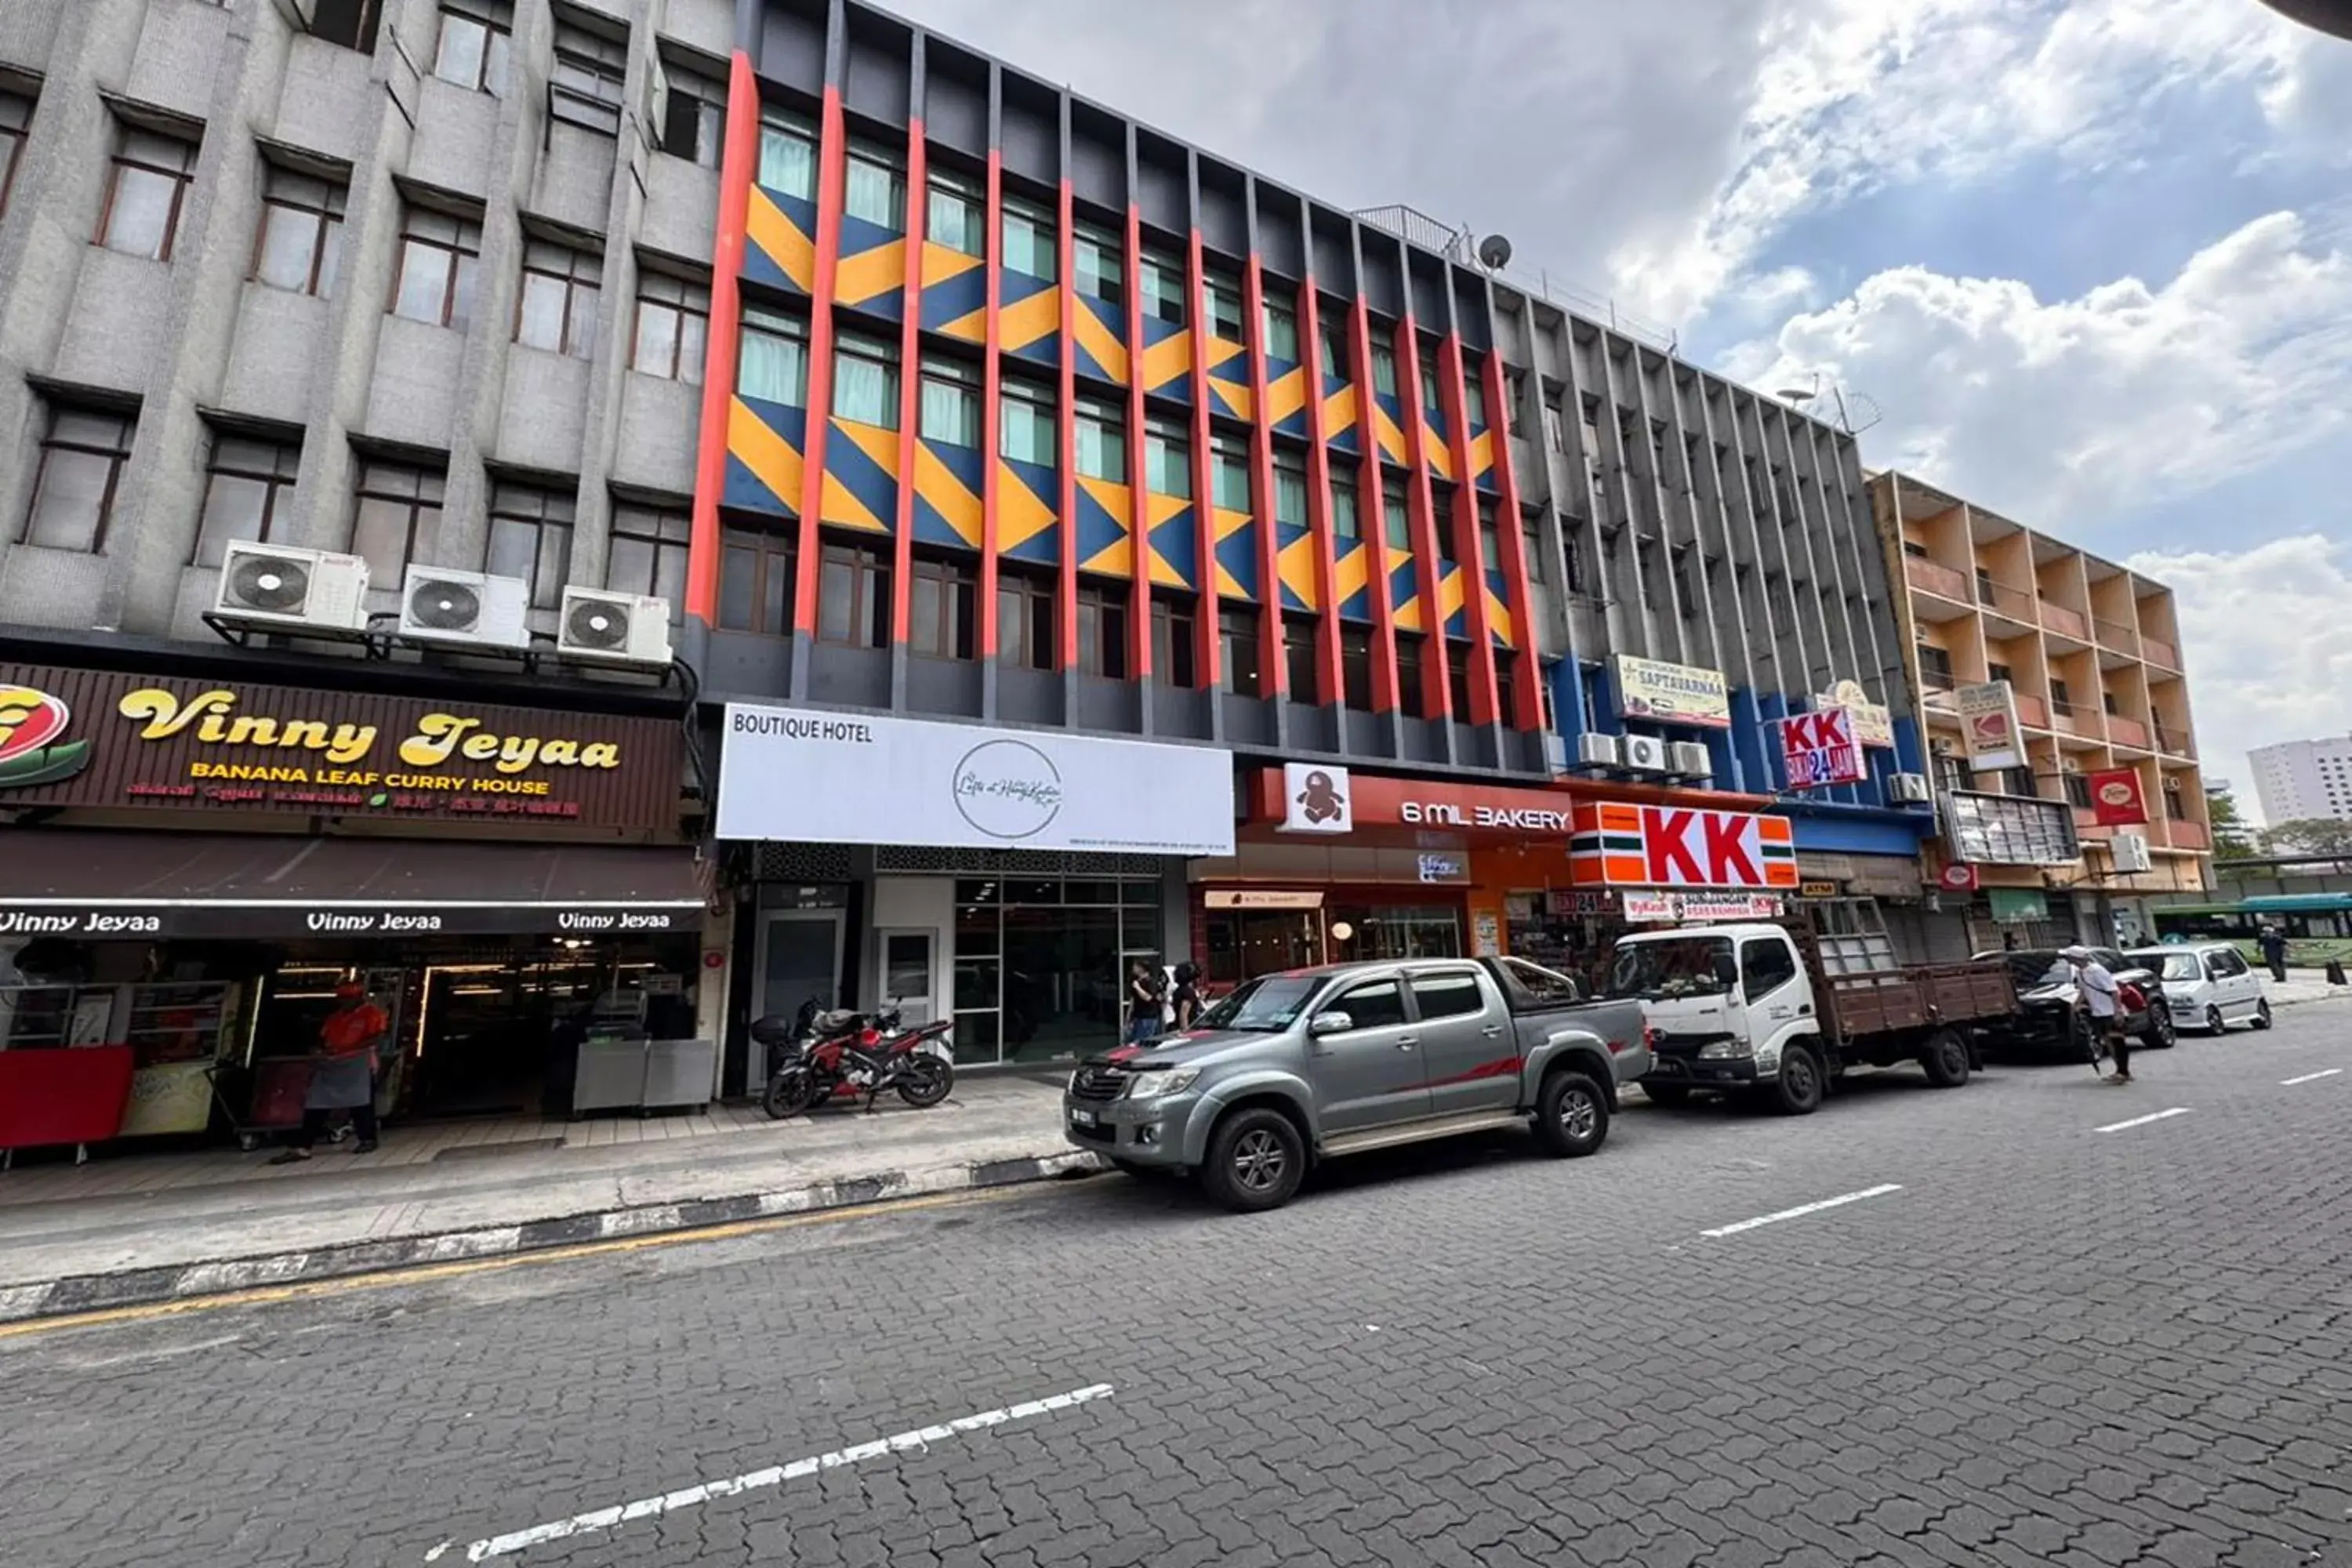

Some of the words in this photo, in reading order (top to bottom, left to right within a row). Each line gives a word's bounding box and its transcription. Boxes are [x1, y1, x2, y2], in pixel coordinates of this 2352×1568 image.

[118, 688, 377, 764] Vinny
[399, 713, 620, 774] Jeyaa
[734, 713, 819, 739] BOUTIQUE
[824, 721, 873, 742] HOTEL
[1784, 710, 1846, 752] KK
[191, 762, 307, 782] BANANA
[316, 769, 379, 785] LEAF
[384, 773, 466, 790] CURRY
[472, 779, 550, 795] HOUSE
[1809, 749, 1831, 781] 24
[1401, 802, 1421, 822] 6
[1425, 804, 1472, 826] MIL
[1474, 806, 1568, 830] BAKERY
[1643, 808, 1762, 884] KK
[0, 912, 77, 931] Vinny
[83, 913, 160, 931] Jeyaa
[307, 913, 374, 931] Vinny
[379, 913, 441, 930] Jeyaa
[558, 913, 614, 928] Vinny
[619, 913, 670, 927] Jeyaa
